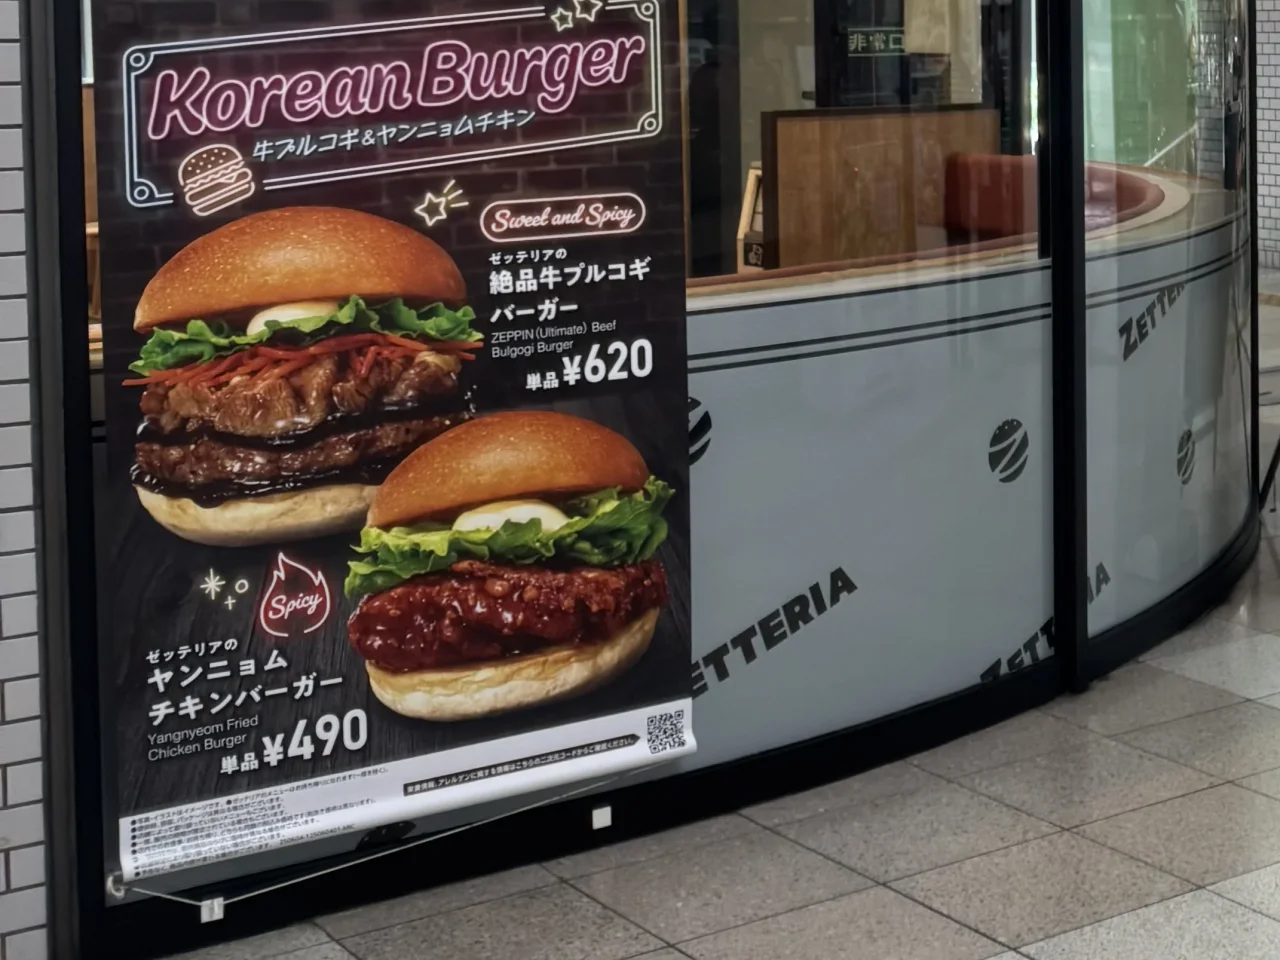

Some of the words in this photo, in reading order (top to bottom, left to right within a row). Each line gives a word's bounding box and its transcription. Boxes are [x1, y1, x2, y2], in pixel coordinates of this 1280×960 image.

[848, 32, 904, 52] 非常口
[148, 60, 411, 139] Korean
[417, 36, 645, 112] Burger
[490, 207, 551, 233] Sweet
[552, 204, 585, 226] and
[585, 203, 636, 229] Spicy
[488, 248, 567, 265] ゼッテリアの
[489, 256, 652, 295] 絶品牛プルコギ
[490, 297, 578, 323] バーガー
[592, 320, 617, 332] Beef
[491, 344, 535, 359] Bulgogi
[537, 340, 574, 356] Burger
[268, 593, 323, 620] Spicy
[691, 566, 858, 700] ETTERIA
[146, 638, 238, 664] ゼッテリアの
[147, 649, 288, 693] ヤンニョム
[149, 672, 343, 726] チキンバーガー
[147, 724, 224, 746] Yangnyeom
[226, 715, 259, 732] Fried
[147, 741, 201, 761] Chicken
[204, 733, 247, 751] Burger
